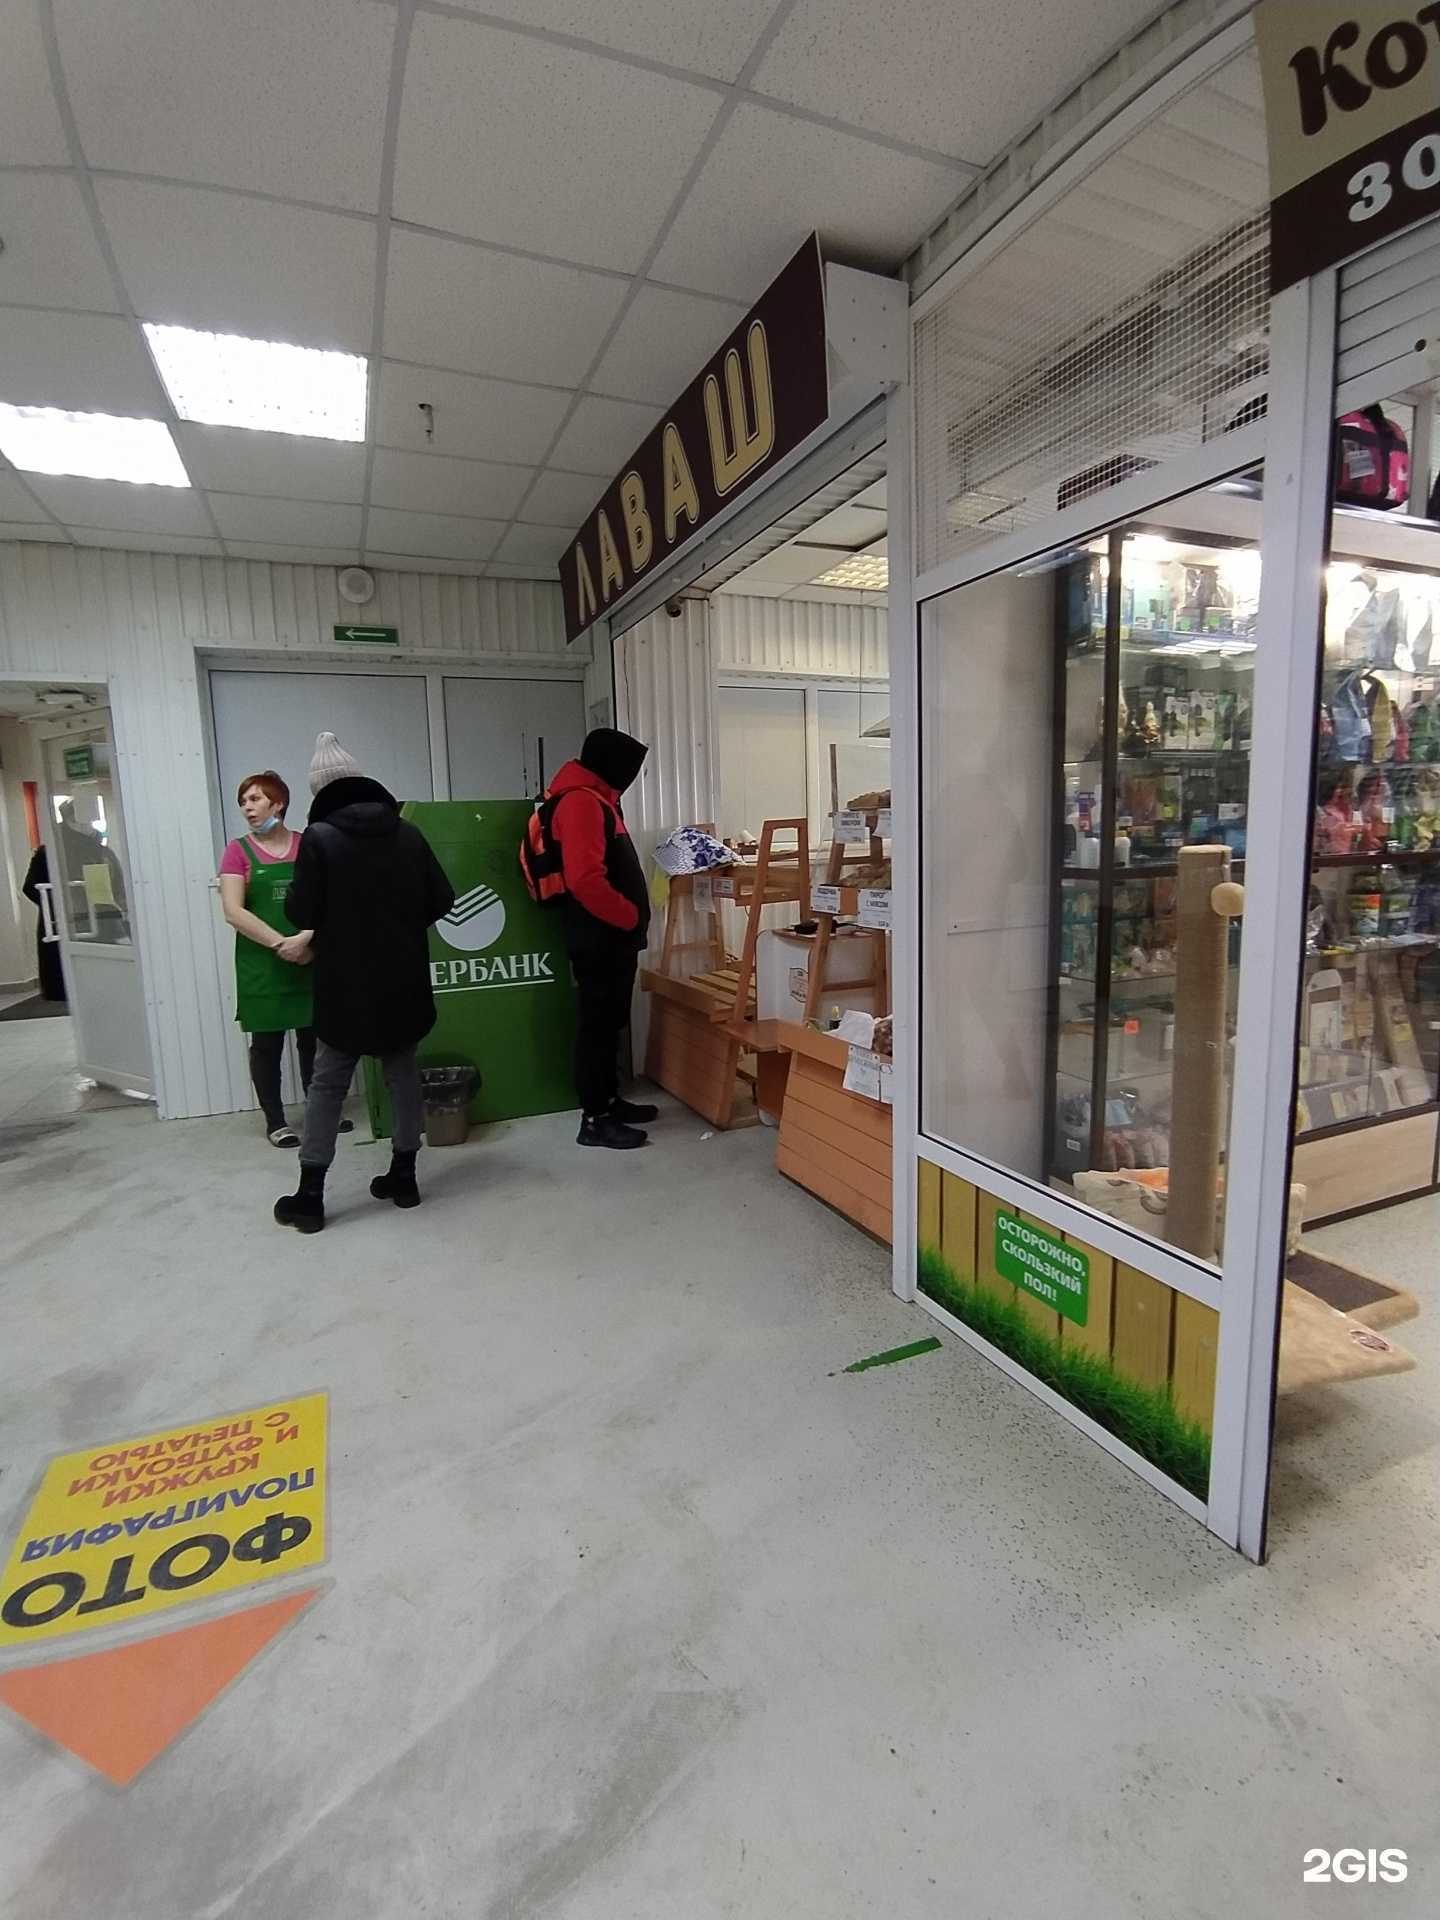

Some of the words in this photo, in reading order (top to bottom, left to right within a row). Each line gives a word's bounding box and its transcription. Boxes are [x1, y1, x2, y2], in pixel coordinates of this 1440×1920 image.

[576, 320, 775, 626] ЛАВАШ
[429, 952, 553, 986] ЕРБАНК
[998, 1217, 1086, 1277] ОСТОРОЖНО,
[1002, 1240, 1082, 1295] СКОЛЬЗКИЙ
[1024, 1272, 1057, 1301] ПОЛ!
[89, 1420, 253, 1471] ПЕЧАТЬЮ
[264, 1411, 290, 1428] С
[275, 1425, 299, 1443] И
[67, 1436, 264, 1496] ФУТБОЛКИ
[102, 1453, 260, 1508] КРУЖКИ
[20, 1467, 315, 1563] ПОЛИГРАФИЯ
[1, 1512, 312, 1628] ФОТО
